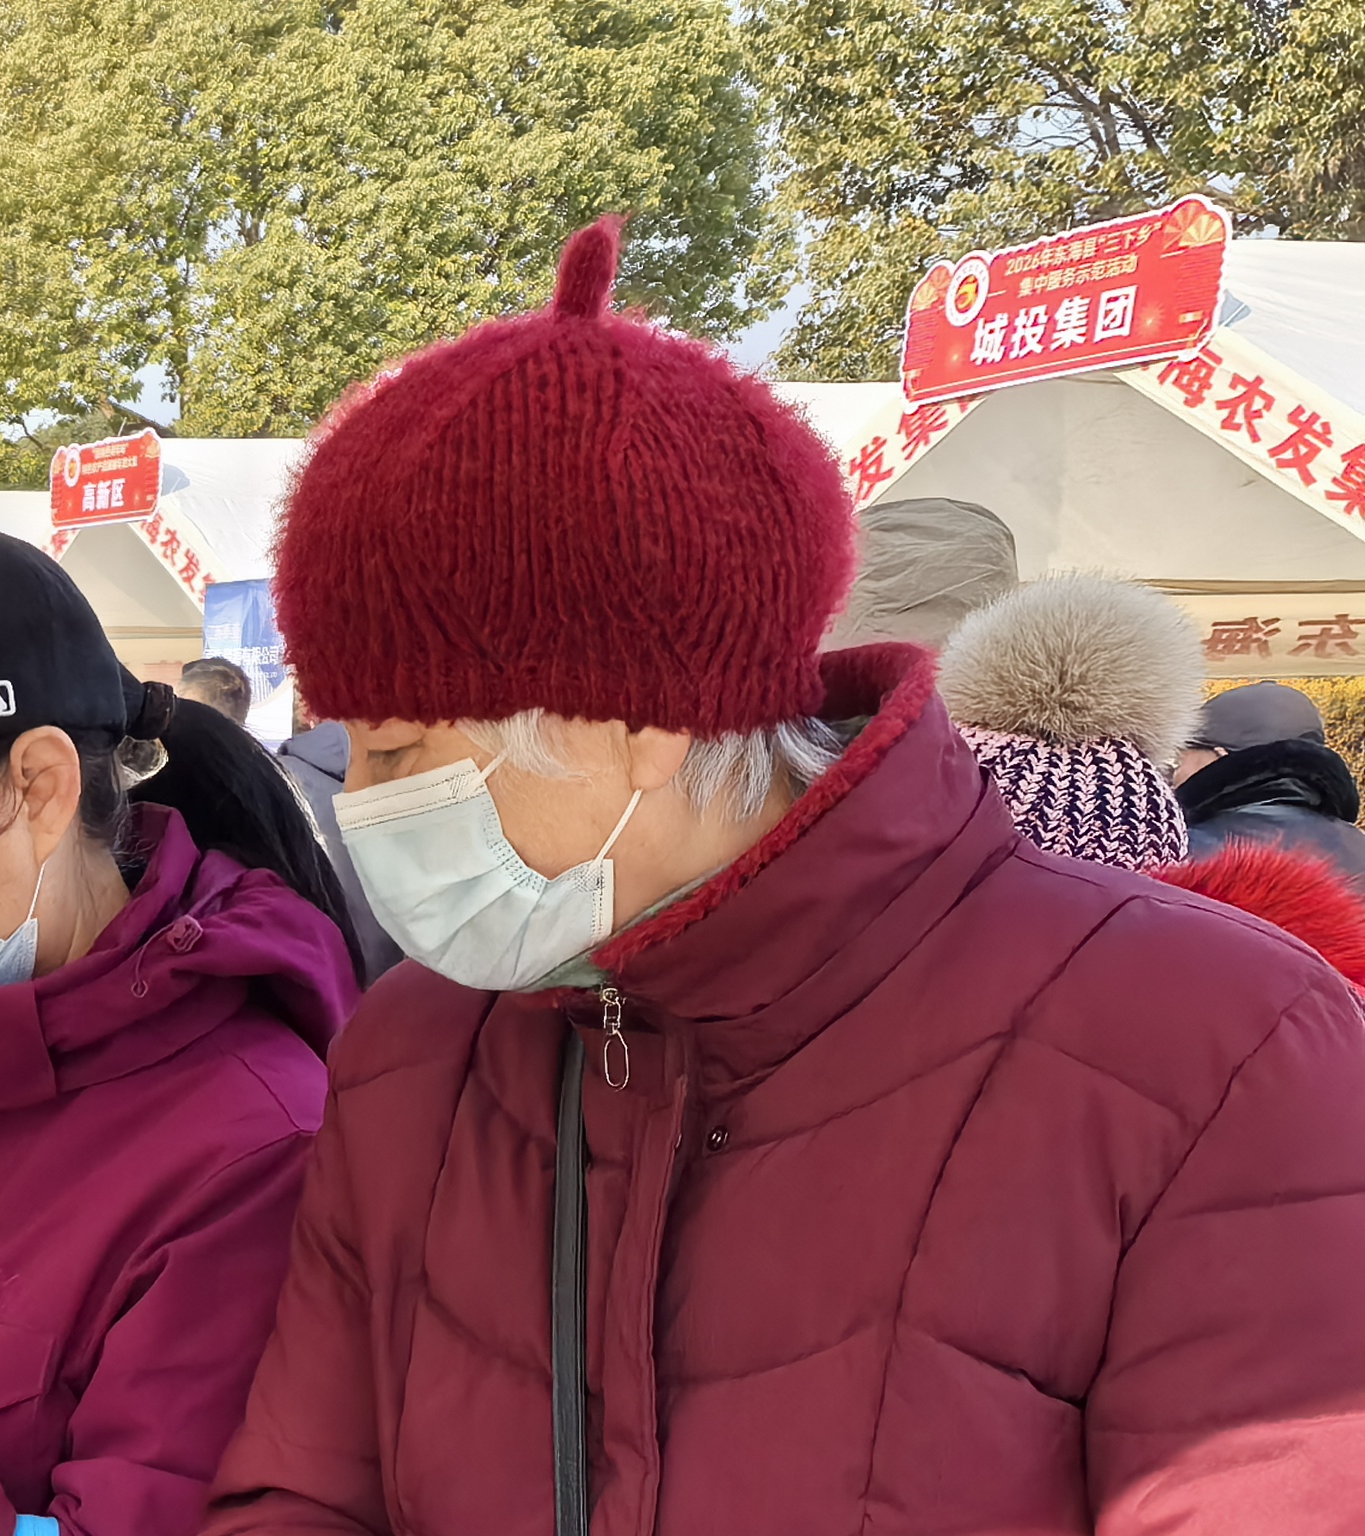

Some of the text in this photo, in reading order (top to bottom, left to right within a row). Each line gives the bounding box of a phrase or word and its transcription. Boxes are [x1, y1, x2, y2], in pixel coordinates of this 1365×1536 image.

[970, 285, 1137, 366] 城投集团
[849, 400, 967, 502] 发集
[1153, 349, 1365, 518] 海农发集
[82, 478, 126, 512] 高新区
